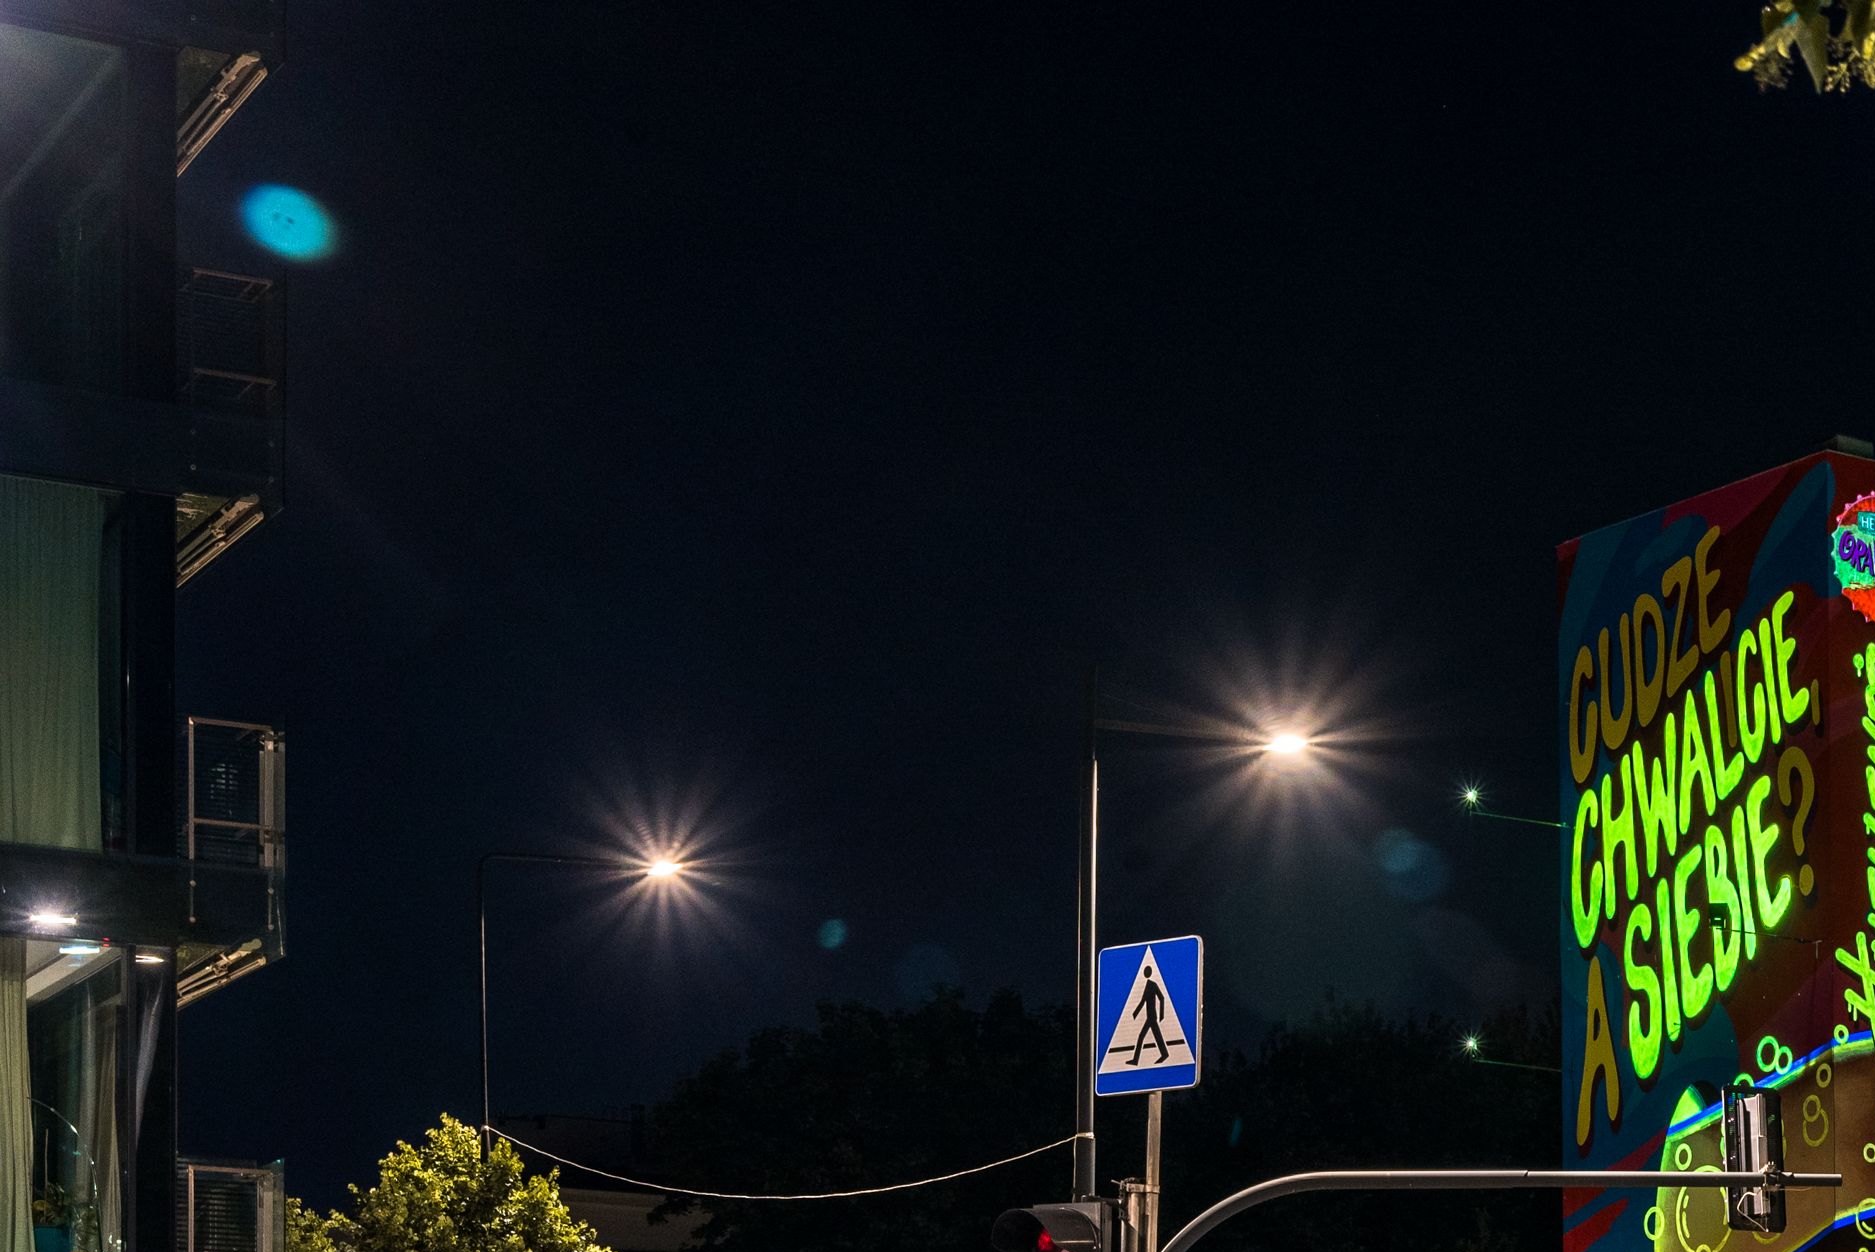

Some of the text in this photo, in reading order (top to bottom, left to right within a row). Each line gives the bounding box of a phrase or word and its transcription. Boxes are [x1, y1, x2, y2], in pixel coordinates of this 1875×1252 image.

[1568, 525, 1732, 785] CUDZE
[1576, 745, 1816, 1148] A SIEBIE?
